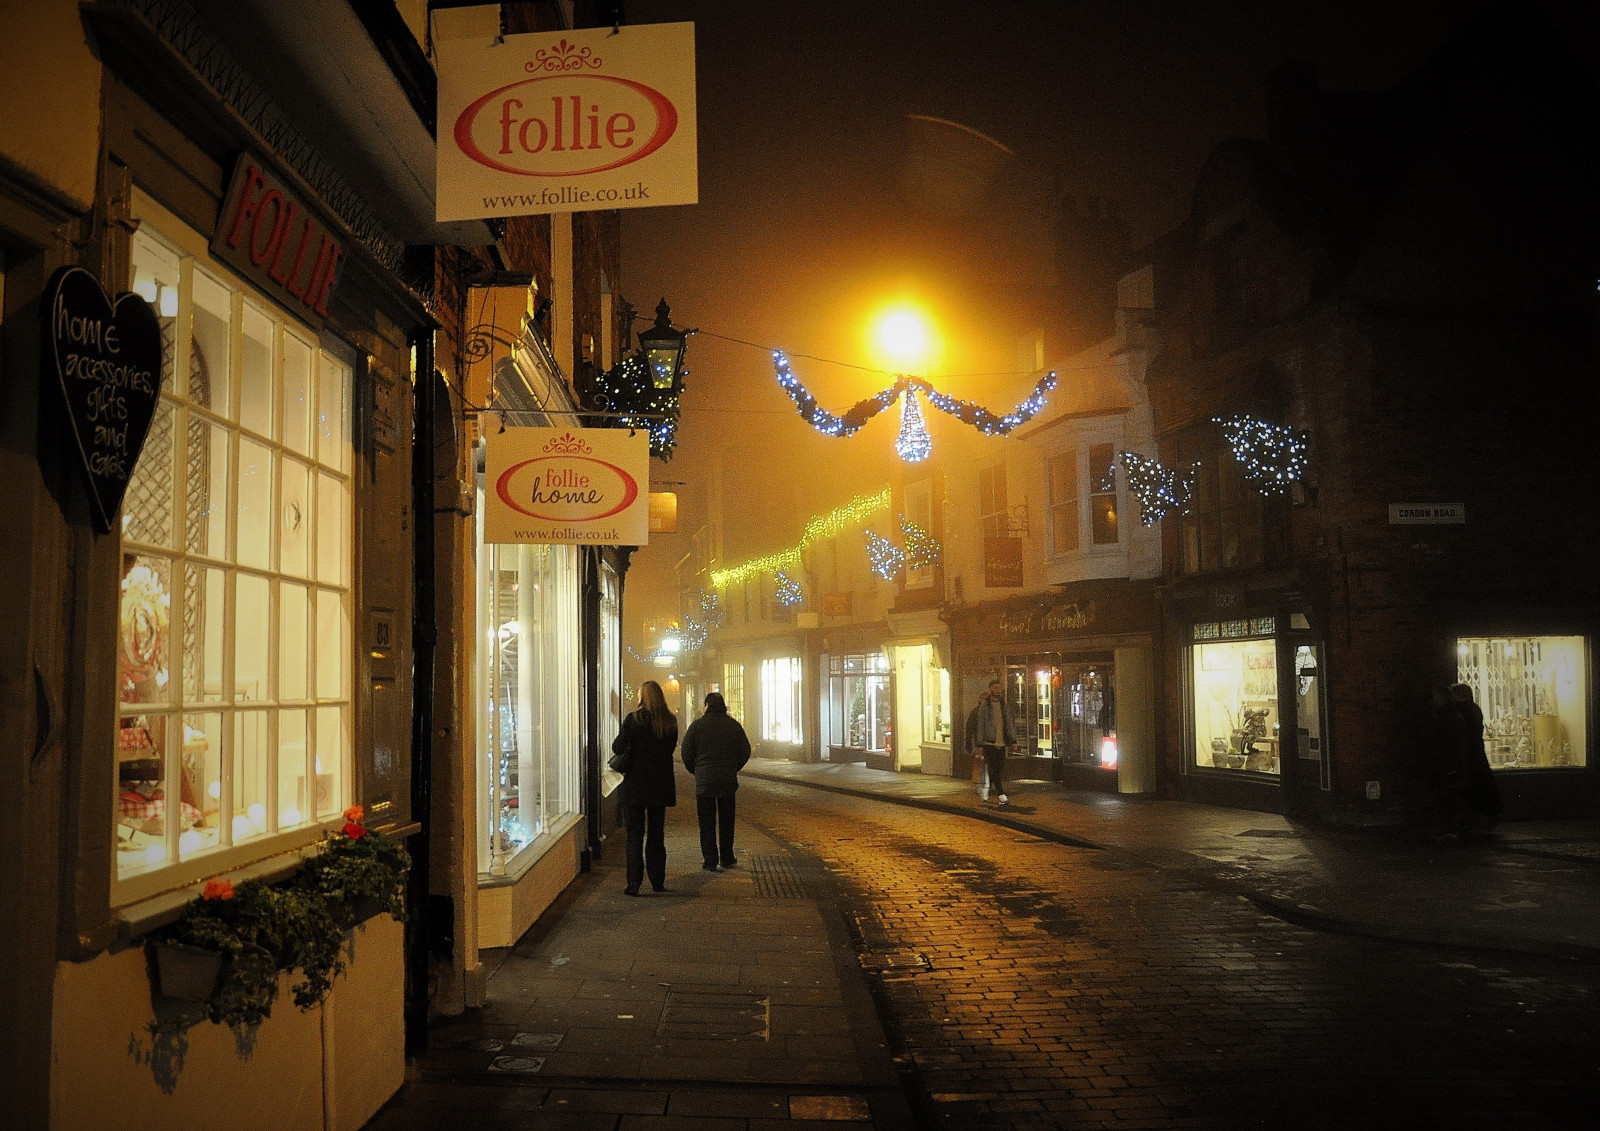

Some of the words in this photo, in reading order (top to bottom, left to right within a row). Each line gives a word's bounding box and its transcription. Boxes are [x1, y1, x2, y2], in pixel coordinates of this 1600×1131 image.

[499, 96, 636, 154] follie
[483, 182, 650, 209] www.follie.co.uk
[226, 165, 342, 318] FOLLIE
[86, 383, 129, 422] gifts
[93, 422, 129, 457] and
[532, 476, 604, 504] home
[545, 469, 590, 488] follie
[513, 528, 620, 541] www.follie.co.uk
[376, 622, 390, 645] 83
